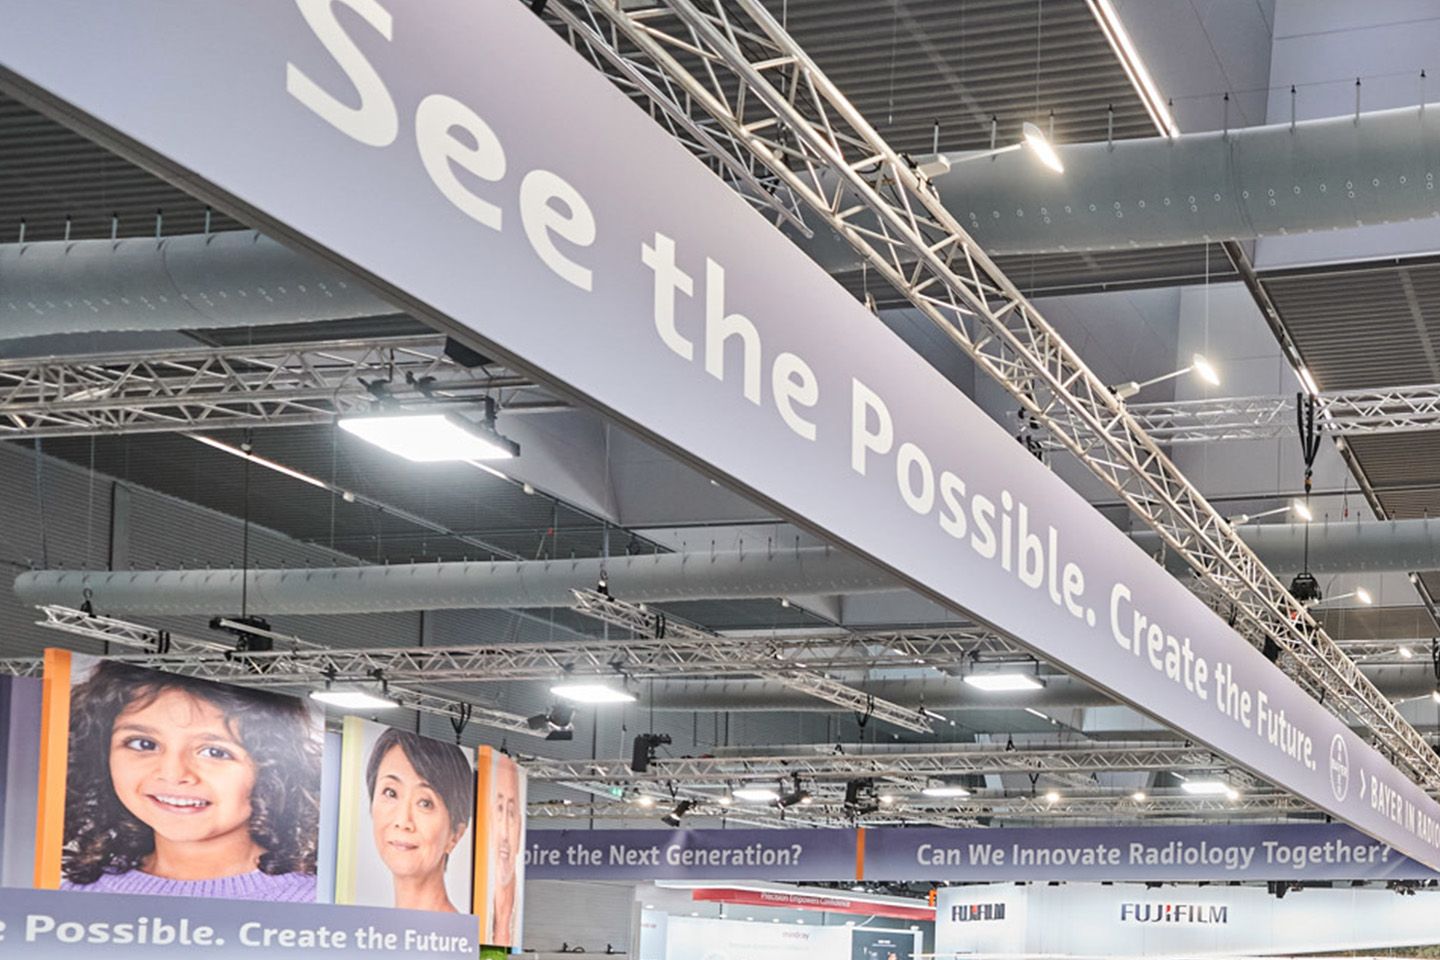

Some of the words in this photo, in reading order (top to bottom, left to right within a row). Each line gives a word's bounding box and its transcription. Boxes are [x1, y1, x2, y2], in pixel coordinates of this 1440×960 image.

[286, 0, 597, 291] See
[641, 231, 820, 442] the
[850, 376, 1097, 628] Possible.
[1110, 582, 1209, 700] Create
[1214, 662, 1251, 729] the
[1257, 690, 1317, 771] Future.
[1371, 775, 1403, 826] BAYER
[1404, 799, 1416, 834] IN
[566, 843, 603, 866] the
[609, 844, 660, 866] Next
[666, 843, 802, 866] Generation?
[916, 843, 961, 866] Can
[968, 843, 1005, 866] We
[1013, 842, 1121, 866] Innovate
[1129, 840, 1255, 870] Radiology
[1262, 839, 1391, 869] Together?
[951, 902, 1006, 922] FUJIFILM
[1120, 903, 1229, 924] FUJIFILM
[25, 914, 225, 946] Possible.
[238, 921, 348, 949] Create
[354, 926, 398, 950] the
[404, 929, 473, 953] Future.
